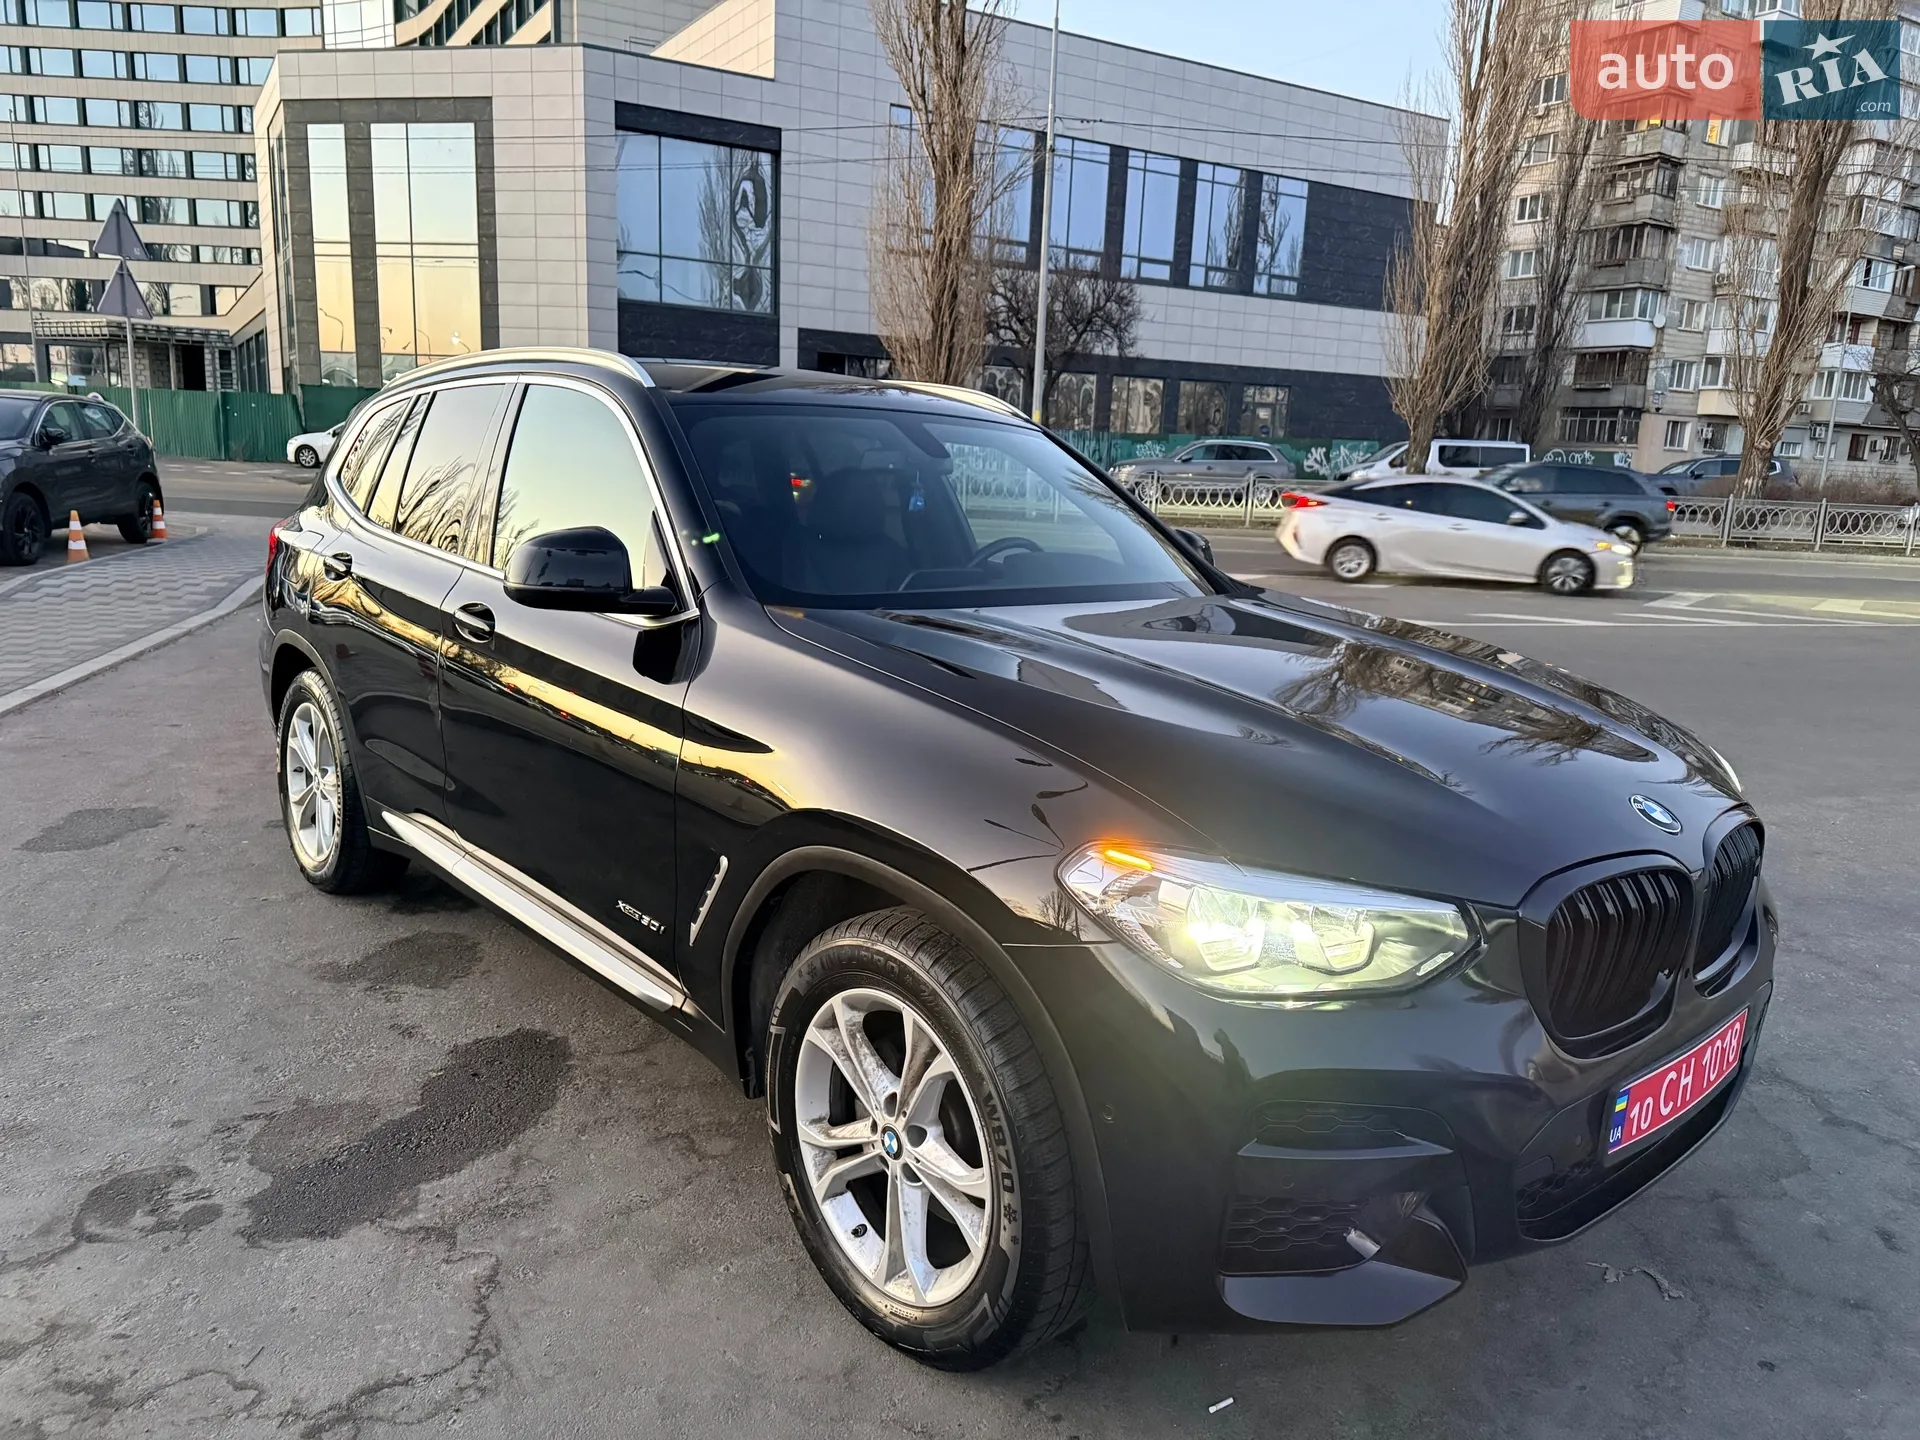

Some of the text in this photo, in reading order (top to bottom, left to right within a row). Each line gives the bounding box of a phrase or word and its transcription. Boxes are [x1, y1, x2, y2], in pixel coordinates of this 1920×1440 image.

[1629, 1021, 1741, 1136] 10 CH 1018
[1609, 1125, 1622, 1143] UA
